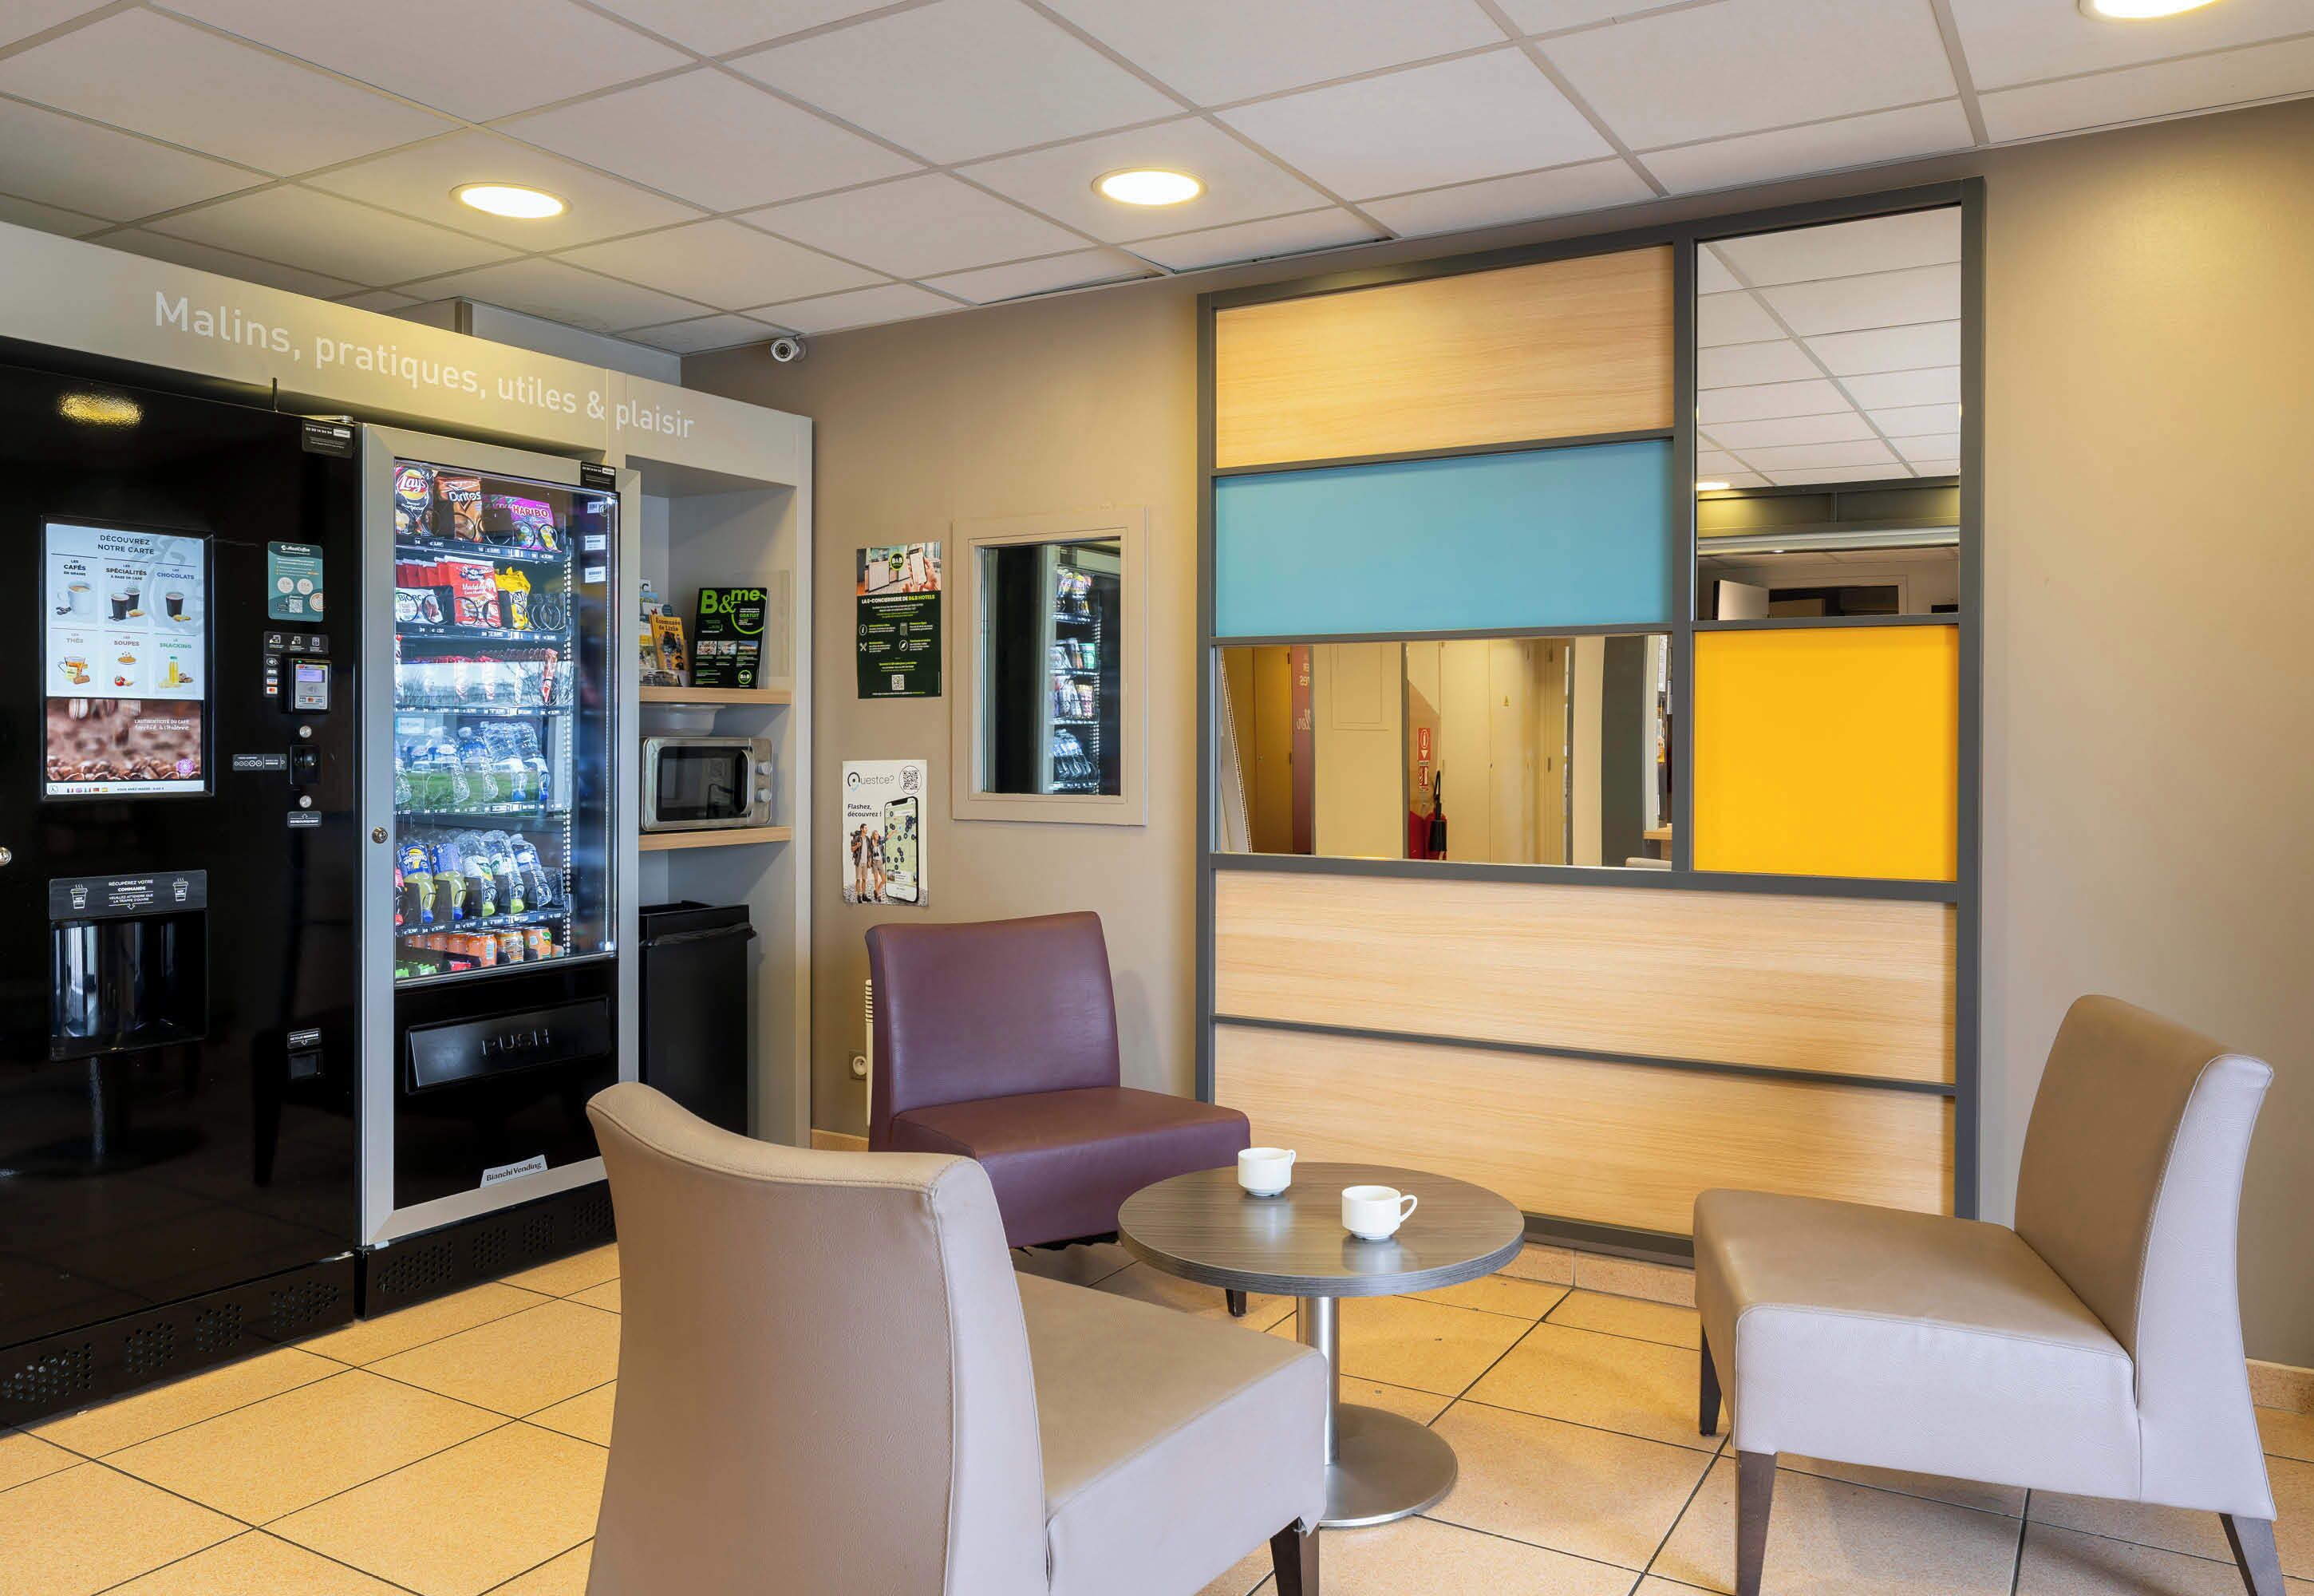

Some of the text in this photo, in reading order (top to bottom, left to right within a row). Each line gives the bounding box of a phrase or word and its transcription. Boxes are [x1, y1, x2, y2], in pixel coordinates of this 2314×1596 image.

[156, 291, 695, 438] Malins, pratiques, utiles & plaisir
[448, 491, 481, 502] Doritos
[511, 504, 549, 517] HARIBO
[100, 534, 150, 546] DÉCOUVREZ
[97, 543, 154, 555] NOTRE CARTE
[106, 567, 147, 576] SPÉCIALITÉS
[156, 571, 195, 580] CHOCOLATS
[701, 589, 761, 614] B&me
[486, 1160, 543, 1182] Bianchi Vending
